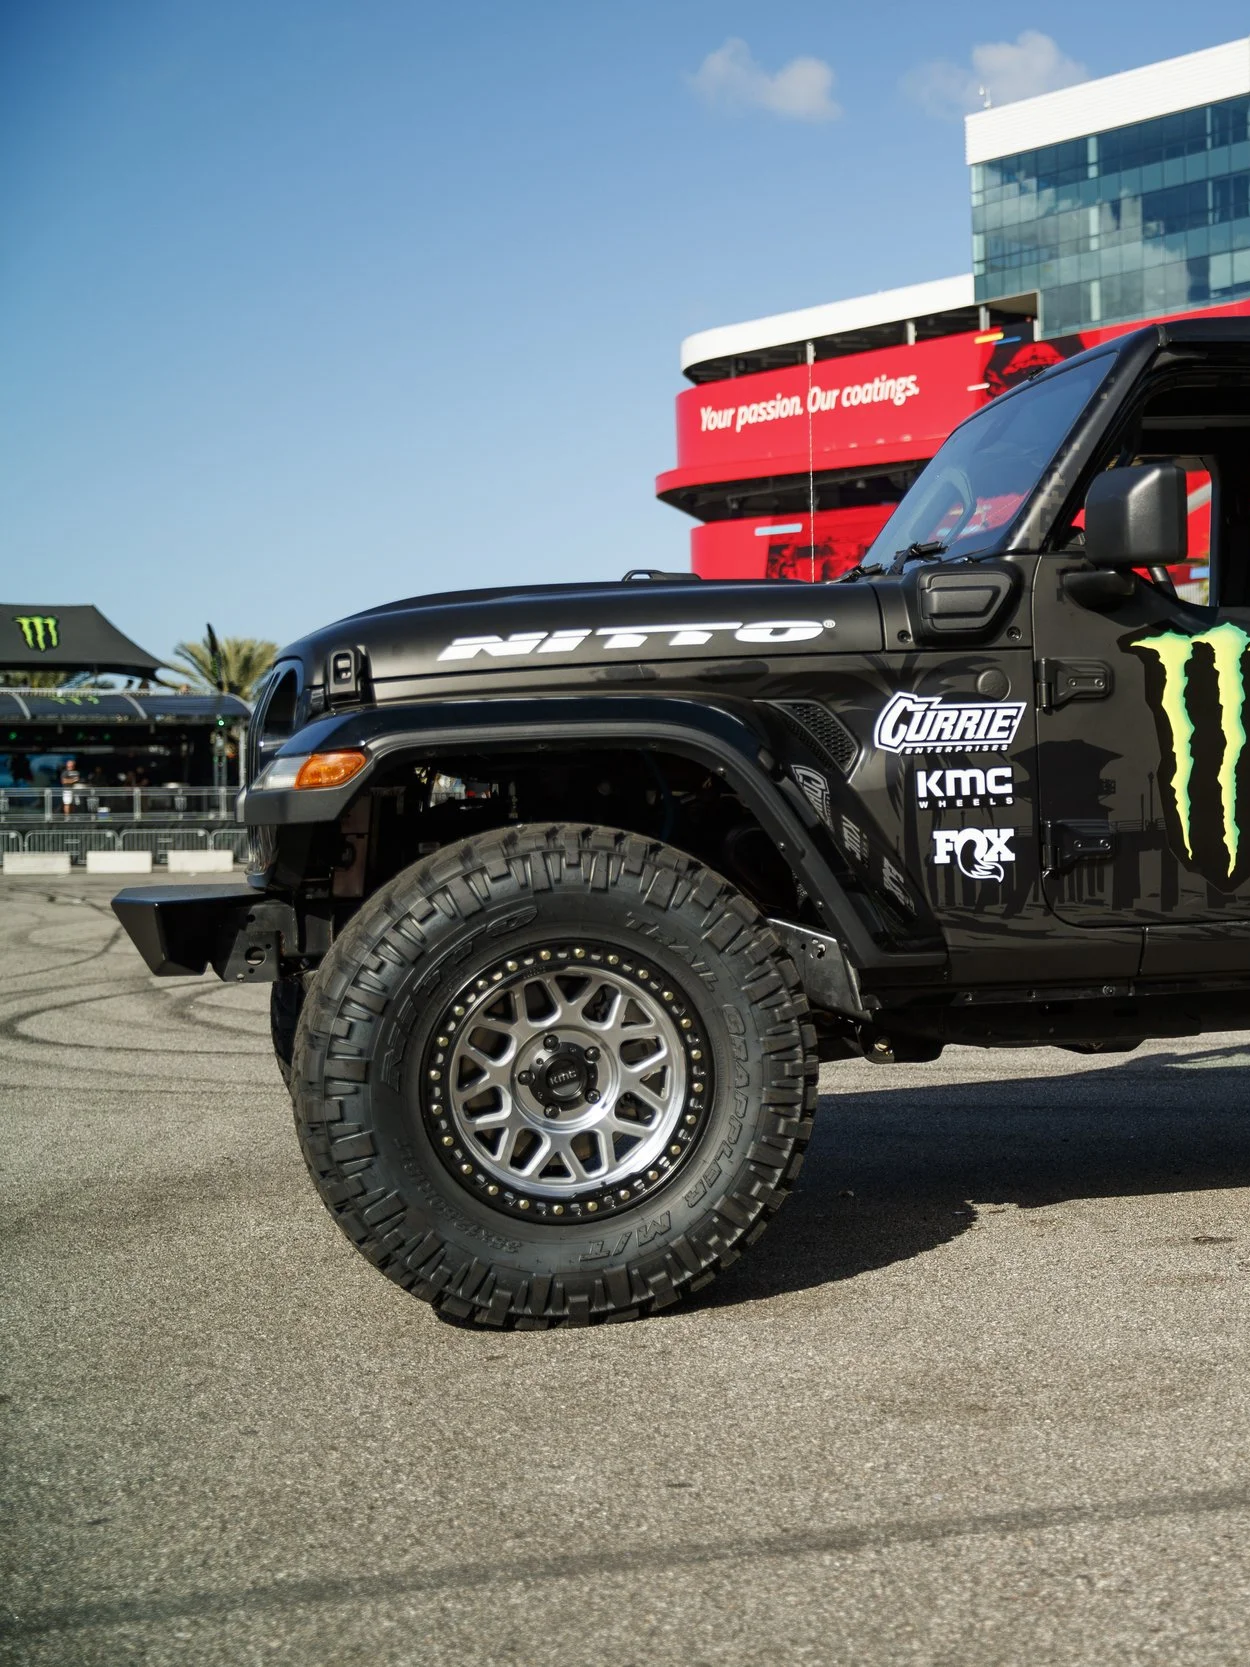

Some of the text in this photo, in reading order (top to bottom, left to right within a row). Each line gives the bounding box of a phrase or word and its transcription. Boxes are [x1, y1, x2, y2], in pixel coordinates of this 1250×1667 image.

[700, 374, 920, 433] Your passion. Our coatings.
[879, 696, 1019, 748] CURRIE
[904, 744, 1009, 756] ENTERPRISES
[918, 796, 1014, 809] WHEELS
[932, 827, 1016, 883] FOX
[684, 1003, 751, 1209] GRAPPLER
[578, 1210, 673, 1263] M/T
